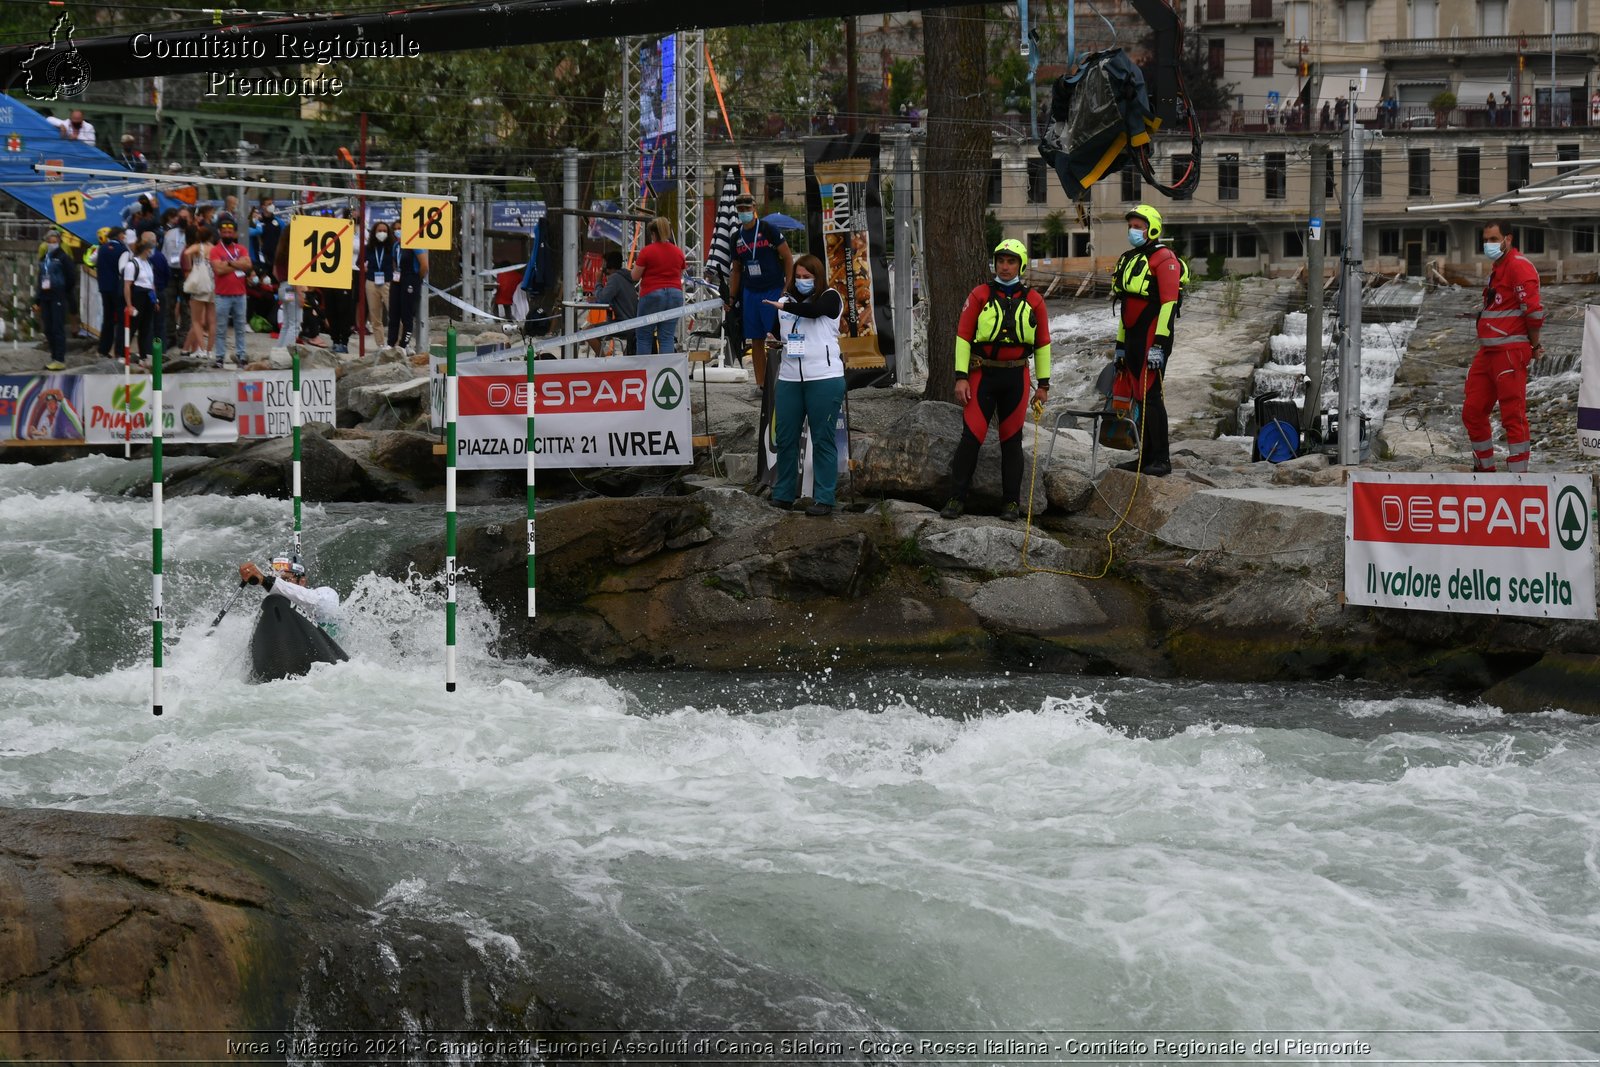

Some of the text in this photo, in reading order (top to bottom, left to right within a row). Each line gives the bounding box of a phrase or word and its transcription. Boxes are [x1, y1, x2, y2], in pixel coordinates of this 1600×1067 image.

[59, 196, 79, 217] 15
[413, 206, 443, 239] 18
[832, 183, 850, 232] KIND
[303, 230, 341, 274] 19
[847, 276, 855, 298] ALMOND
[848, 299, 857, 323] CARAMEL
[487, 377, 645, 408] DESPAR
[458, 438, 509, 455] PIAZZA
[581, 435, 597, 454] 21
[608, 430, 680, 457] IVREA
[1381, 495, 1546, 536] DESPAR
[1367, 563, 1572, 605] Il valore della scelta
